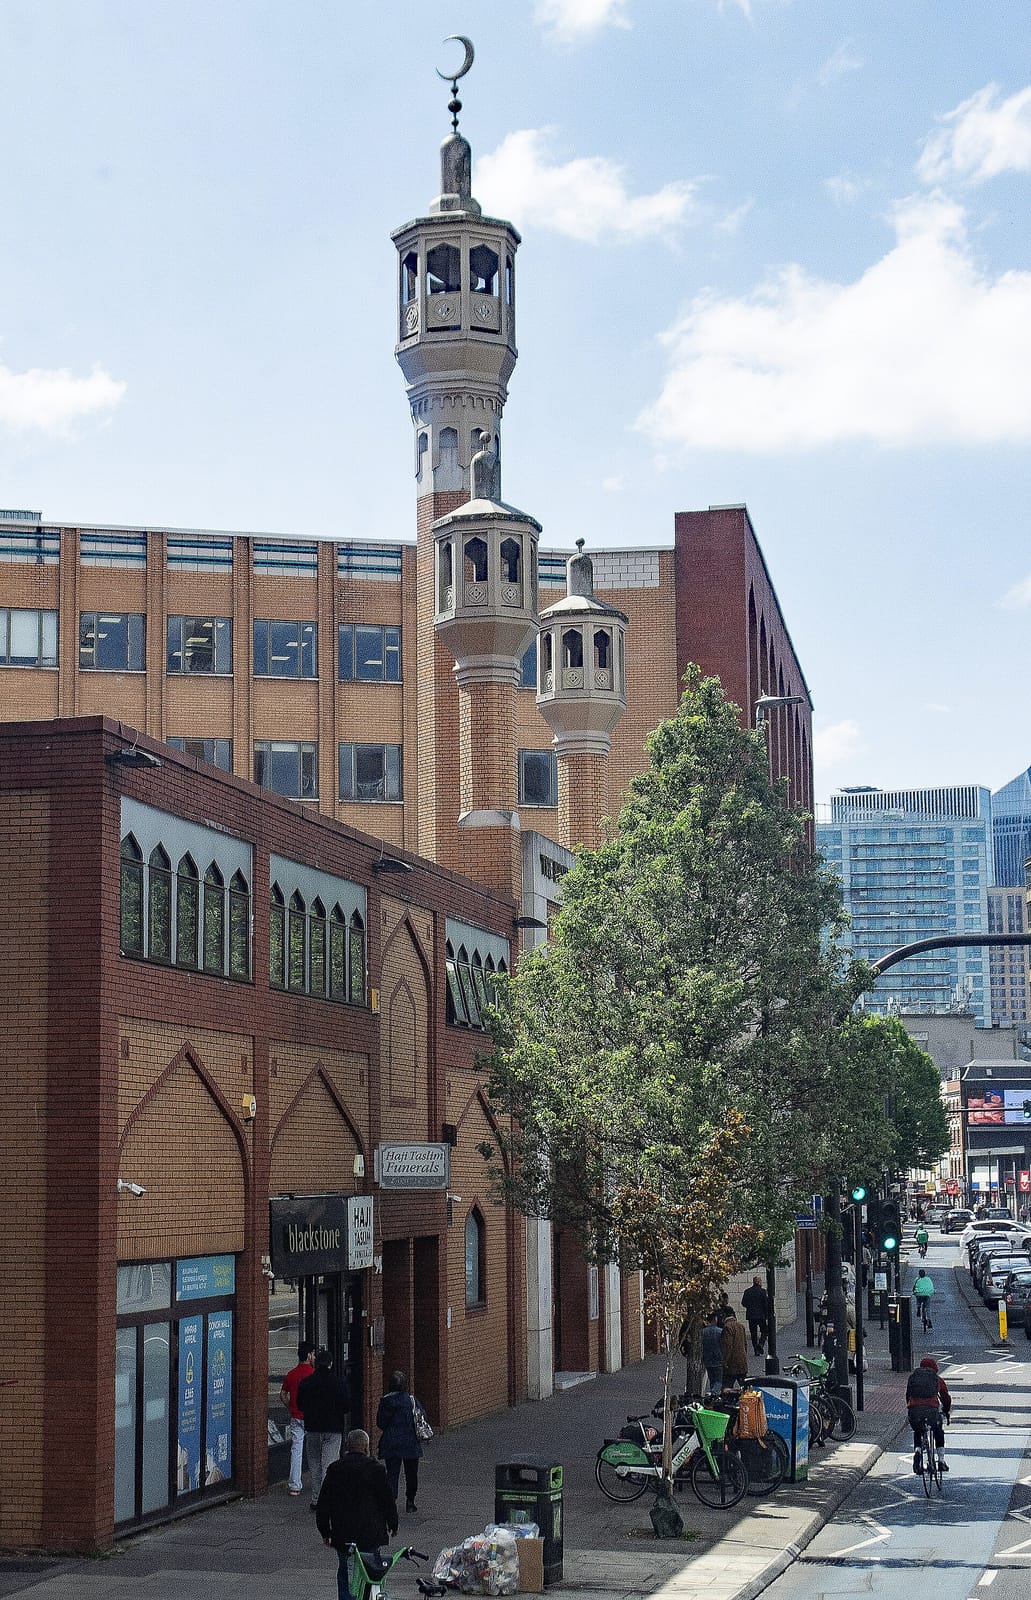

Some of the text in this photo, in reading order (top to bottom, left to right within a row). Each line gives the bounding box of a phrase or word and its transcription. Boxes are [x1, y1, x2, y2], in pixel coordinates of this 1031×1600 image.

[385, 1150, 444, 1163] Haji Taslim
[384, 1161, 440, 1173] Funerals
[353, 1206, 371, 1228] HAJI
[288, 1223, 341, 1253] blackstone
